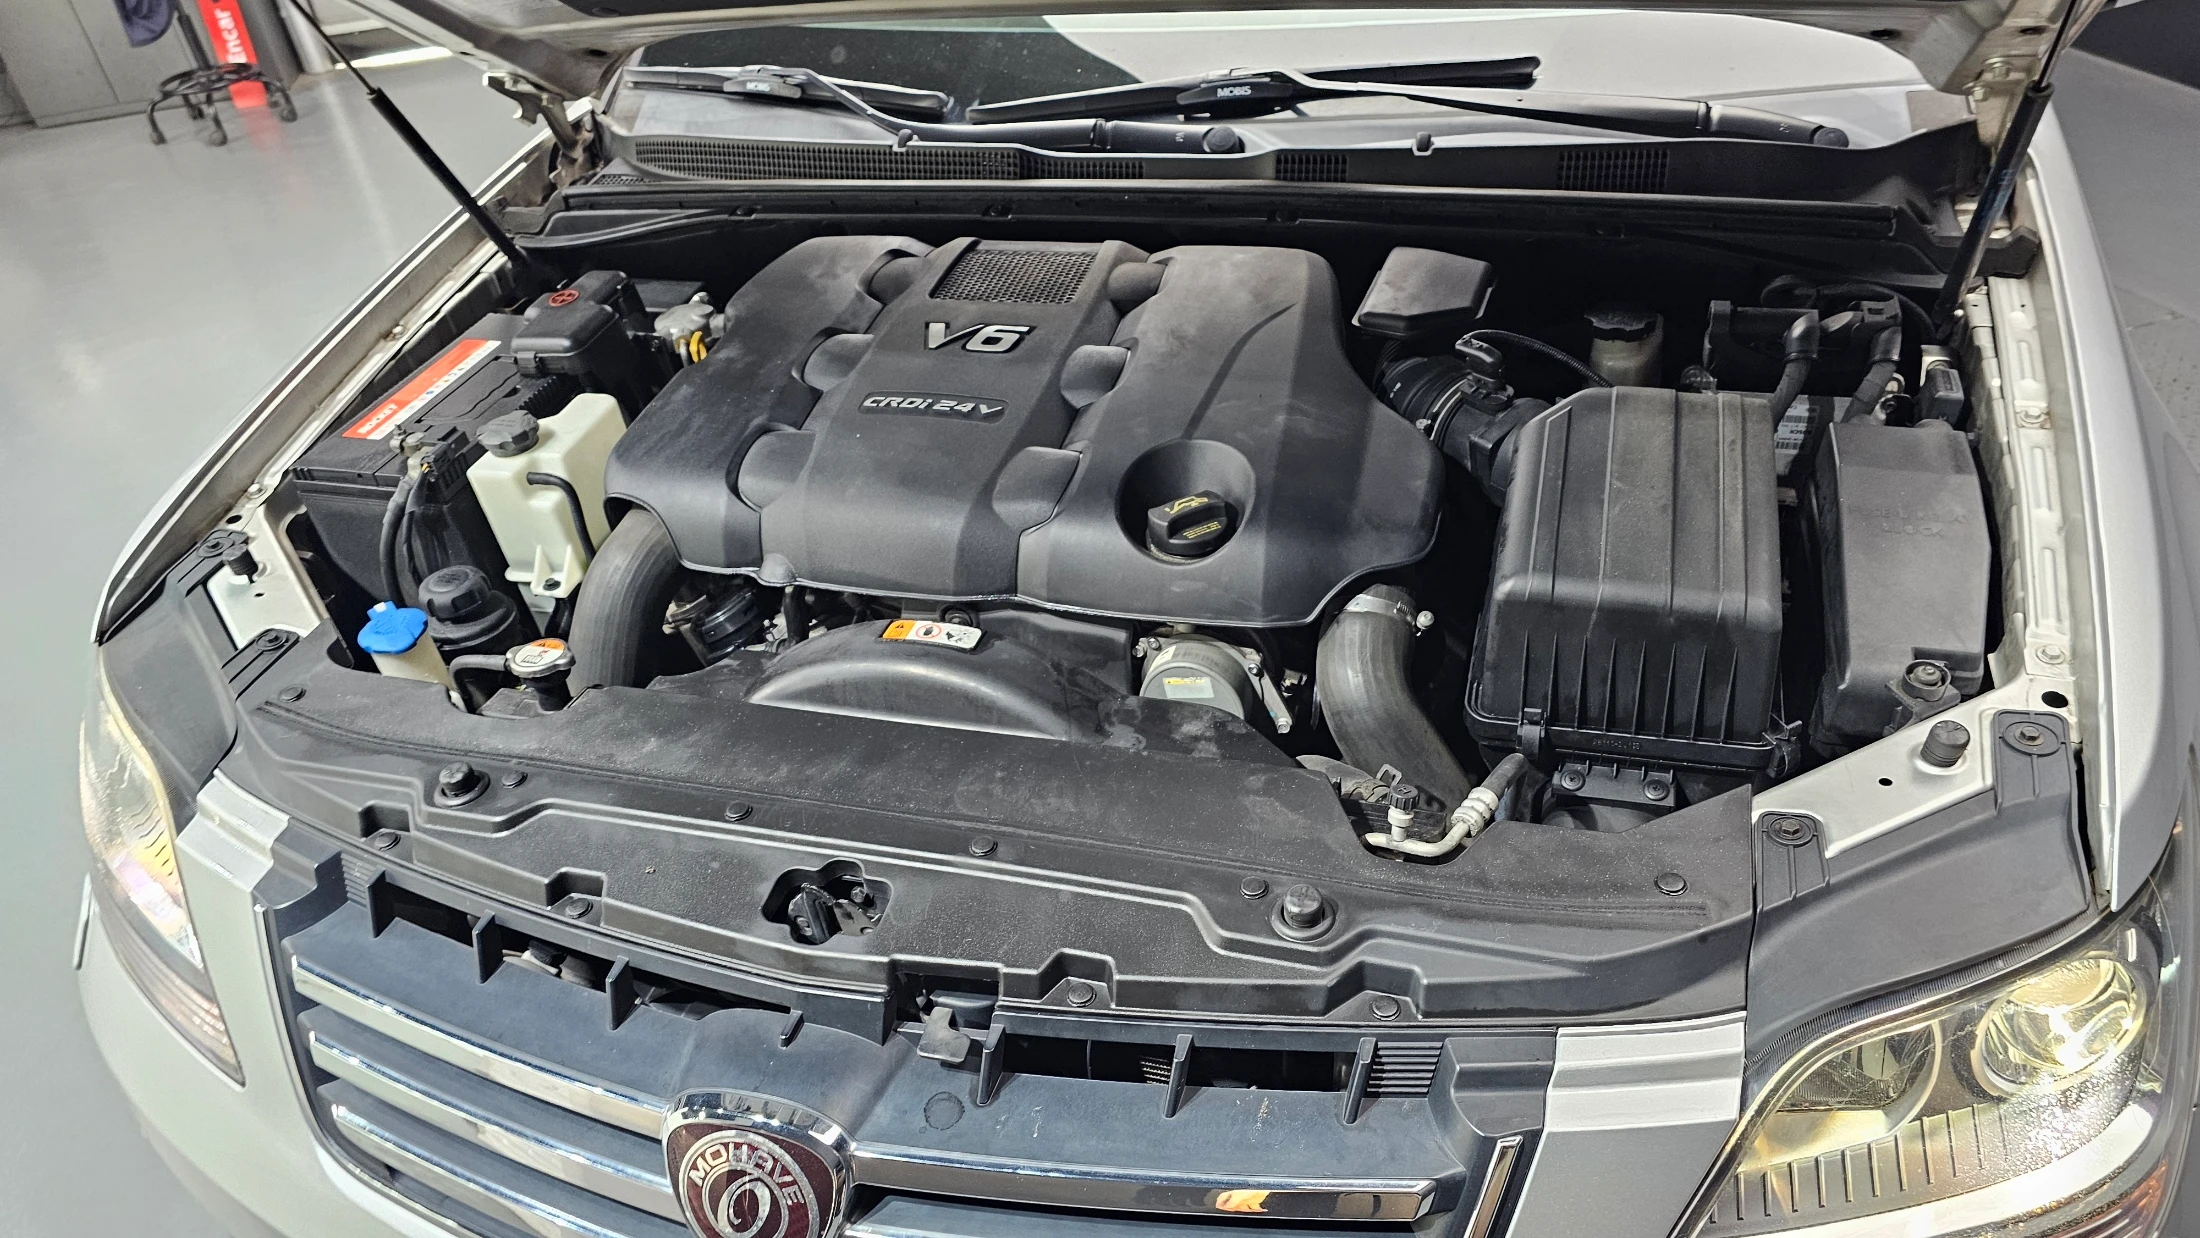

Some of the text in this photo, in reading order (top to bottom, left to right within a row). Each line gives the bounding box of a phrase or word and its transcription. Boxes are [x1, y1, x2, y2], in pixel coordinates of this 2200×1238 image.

[1217, 86, 1251, 97] MOBIS
[927, 322, 1032, 352] V6
[862, 396, 1004, 414] CRDi 24V
[688, 1141, 806, 1206] MOHAVE
